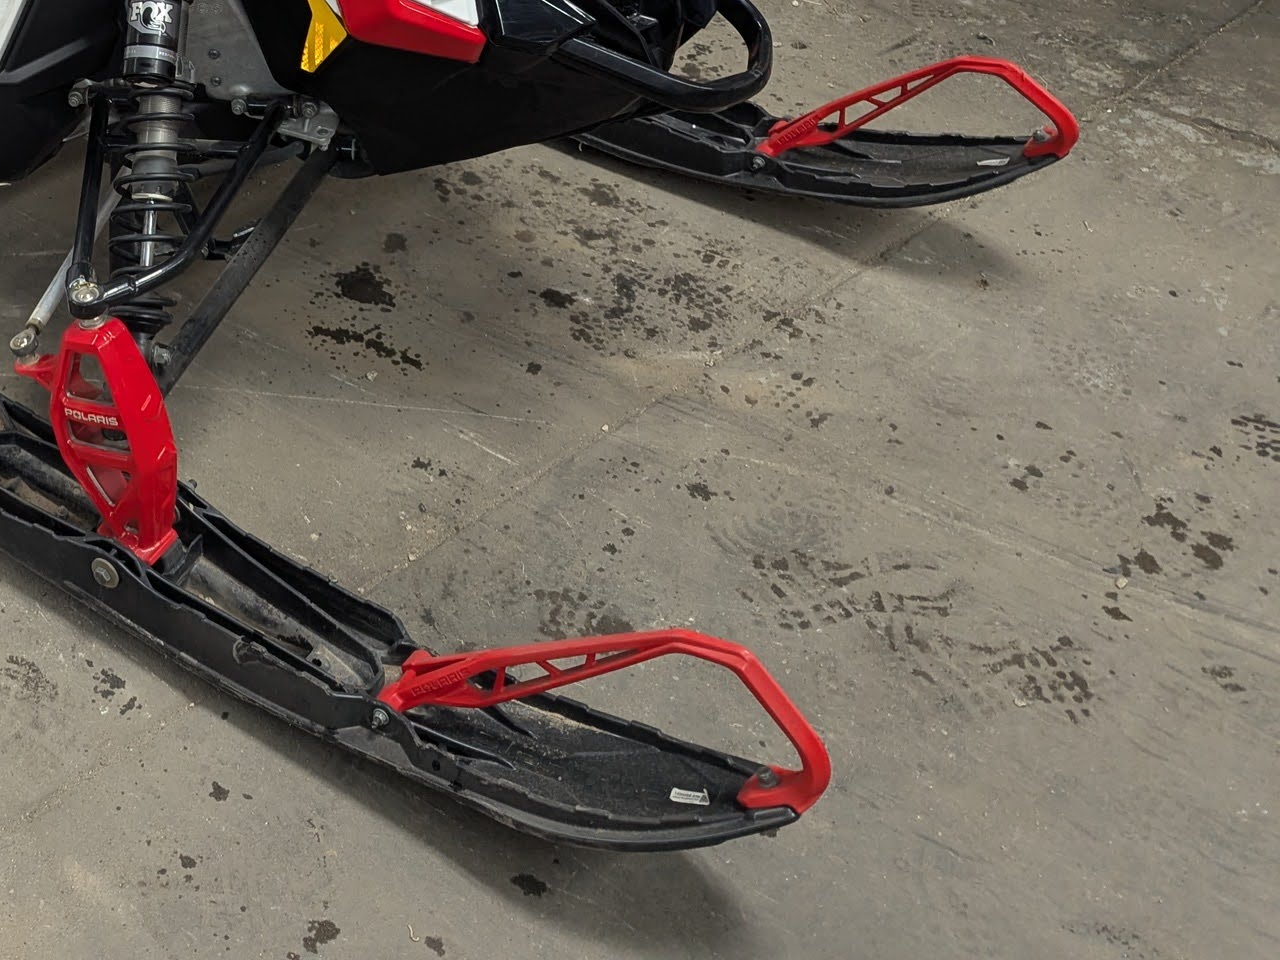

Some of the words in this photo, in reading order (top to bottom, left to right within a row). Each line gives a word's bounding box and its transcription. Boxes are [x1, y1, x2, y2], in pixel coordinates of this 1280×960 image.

[130, 1, 173, 32] FOX
[64, 407, 119, 427] POLARIS
[410, 666, 471, 697] POLARIS
